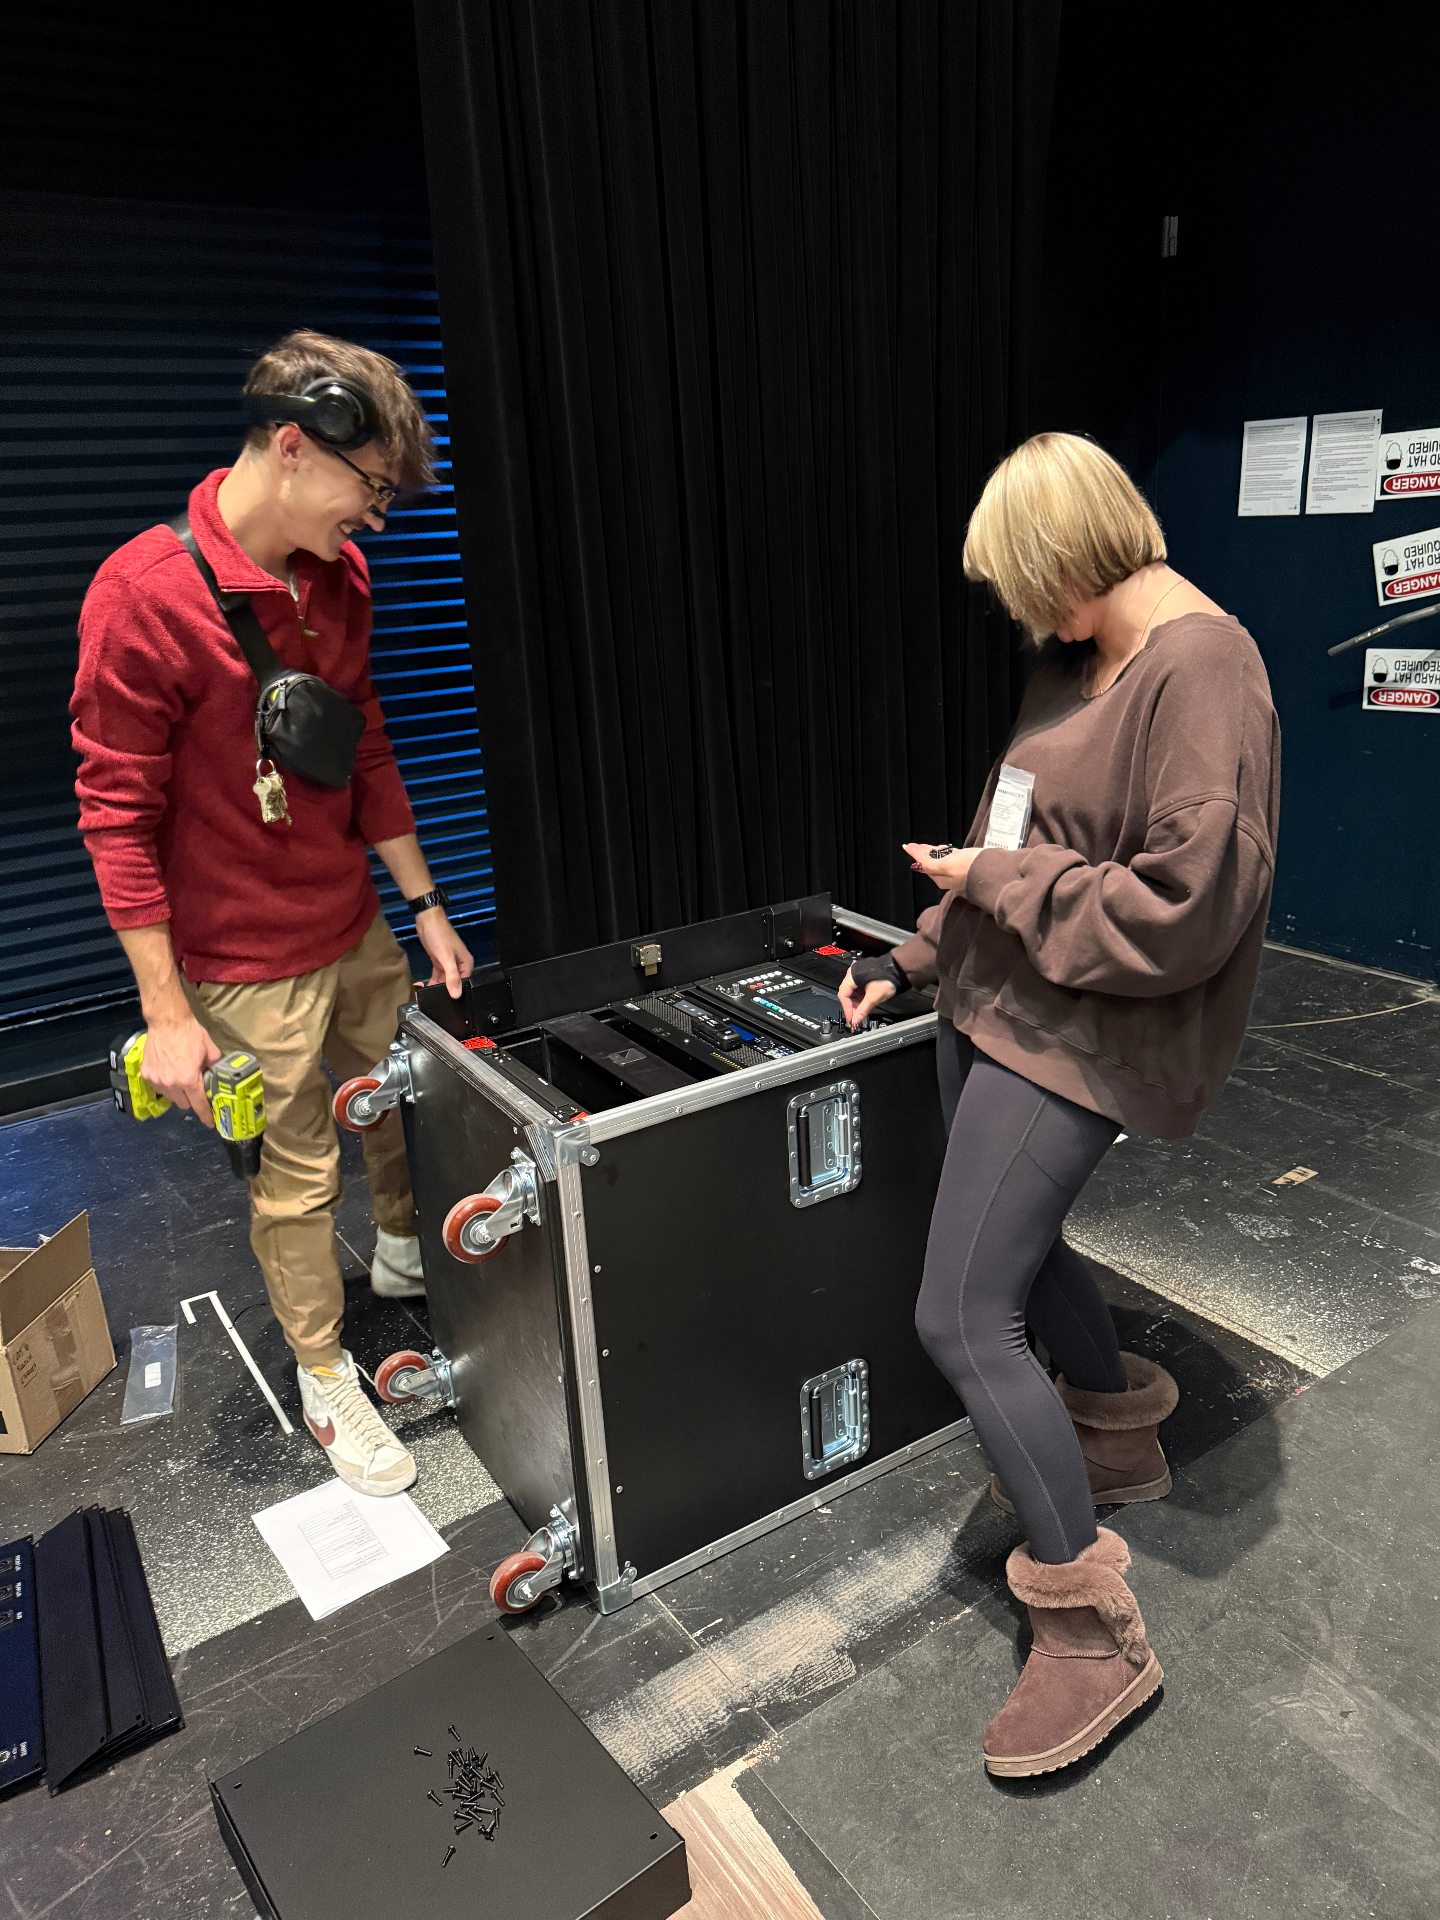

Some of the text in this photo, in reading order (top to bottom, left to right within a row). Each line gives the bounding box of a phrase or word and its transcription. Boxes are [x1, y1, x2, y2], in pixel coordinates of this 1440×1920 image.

[1408, 440, 1440, 455] UIRED
[1407, 454, 1428, 468] HAT
[1392, 475, 1440, 490] ANGER
[1404, 557, 1425, 572] HAT
[1393, 574, 1440, 594] ANGER
[1393, 672, 1440, 685] HARD HAT
[1378, 691, 1431, 704] DANGER
